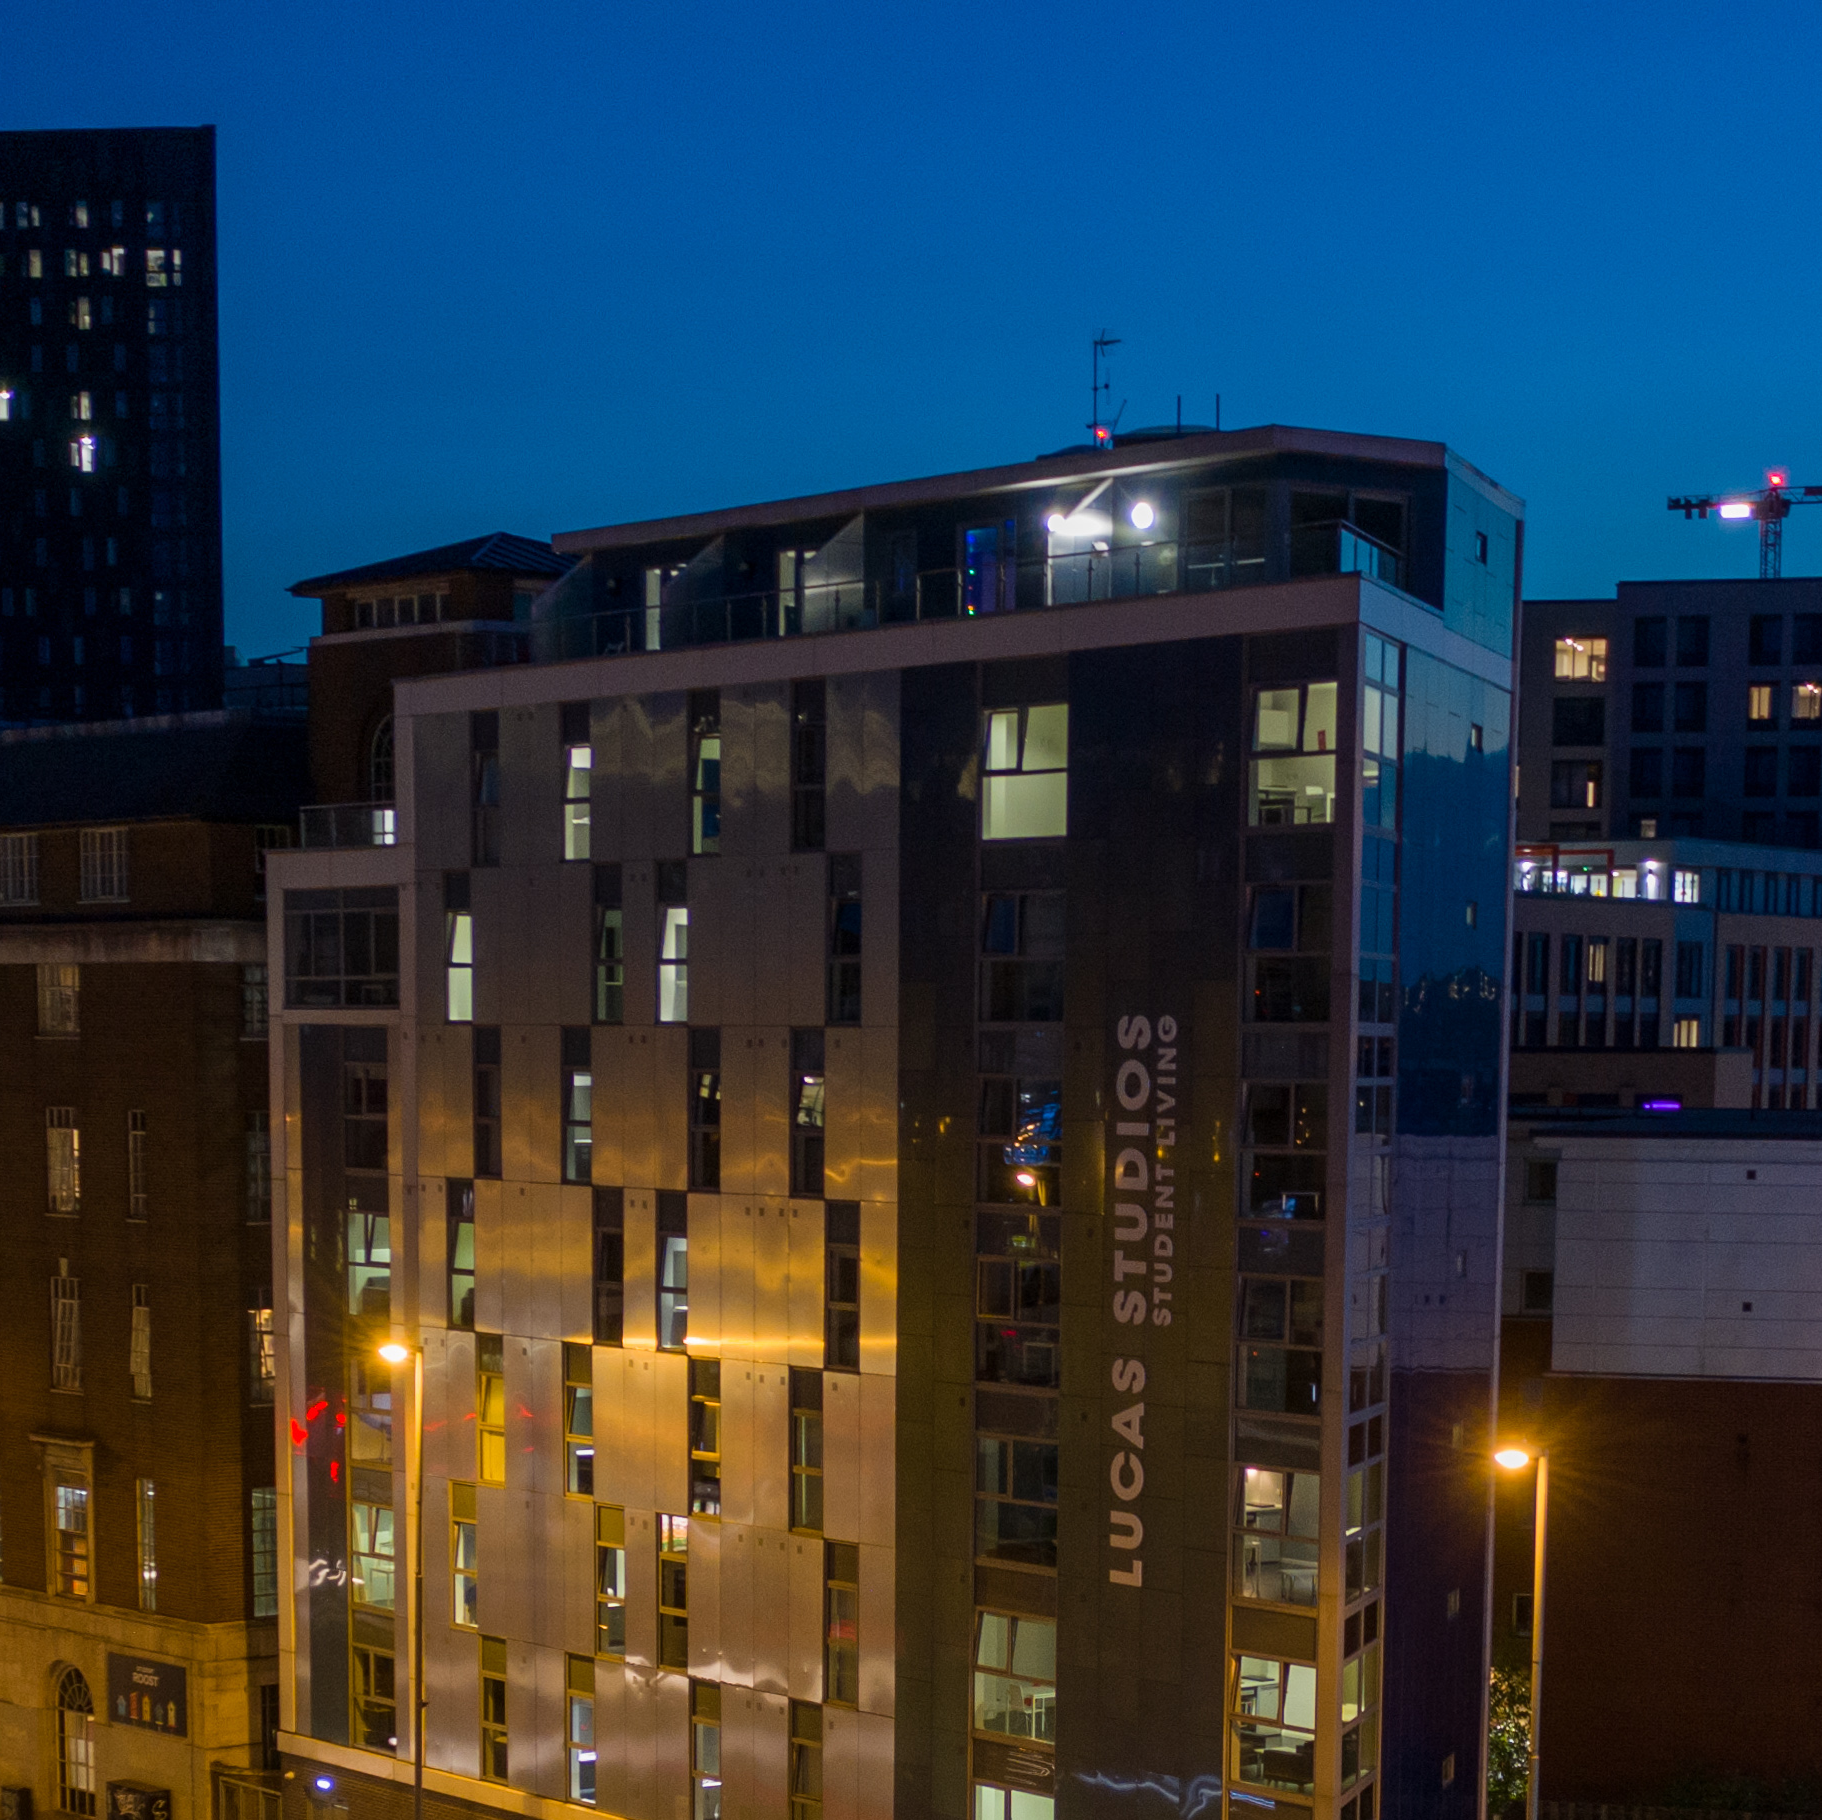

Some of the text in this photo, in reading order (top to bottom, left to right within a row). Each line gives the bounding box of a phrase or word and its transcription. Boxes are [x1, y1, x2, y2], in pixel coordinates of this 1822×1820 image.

[1109, 1014, 1151, 1588] LUCAS STUDIOS
[1152, 1014, 1178, 1327] STUDENT LIVING
